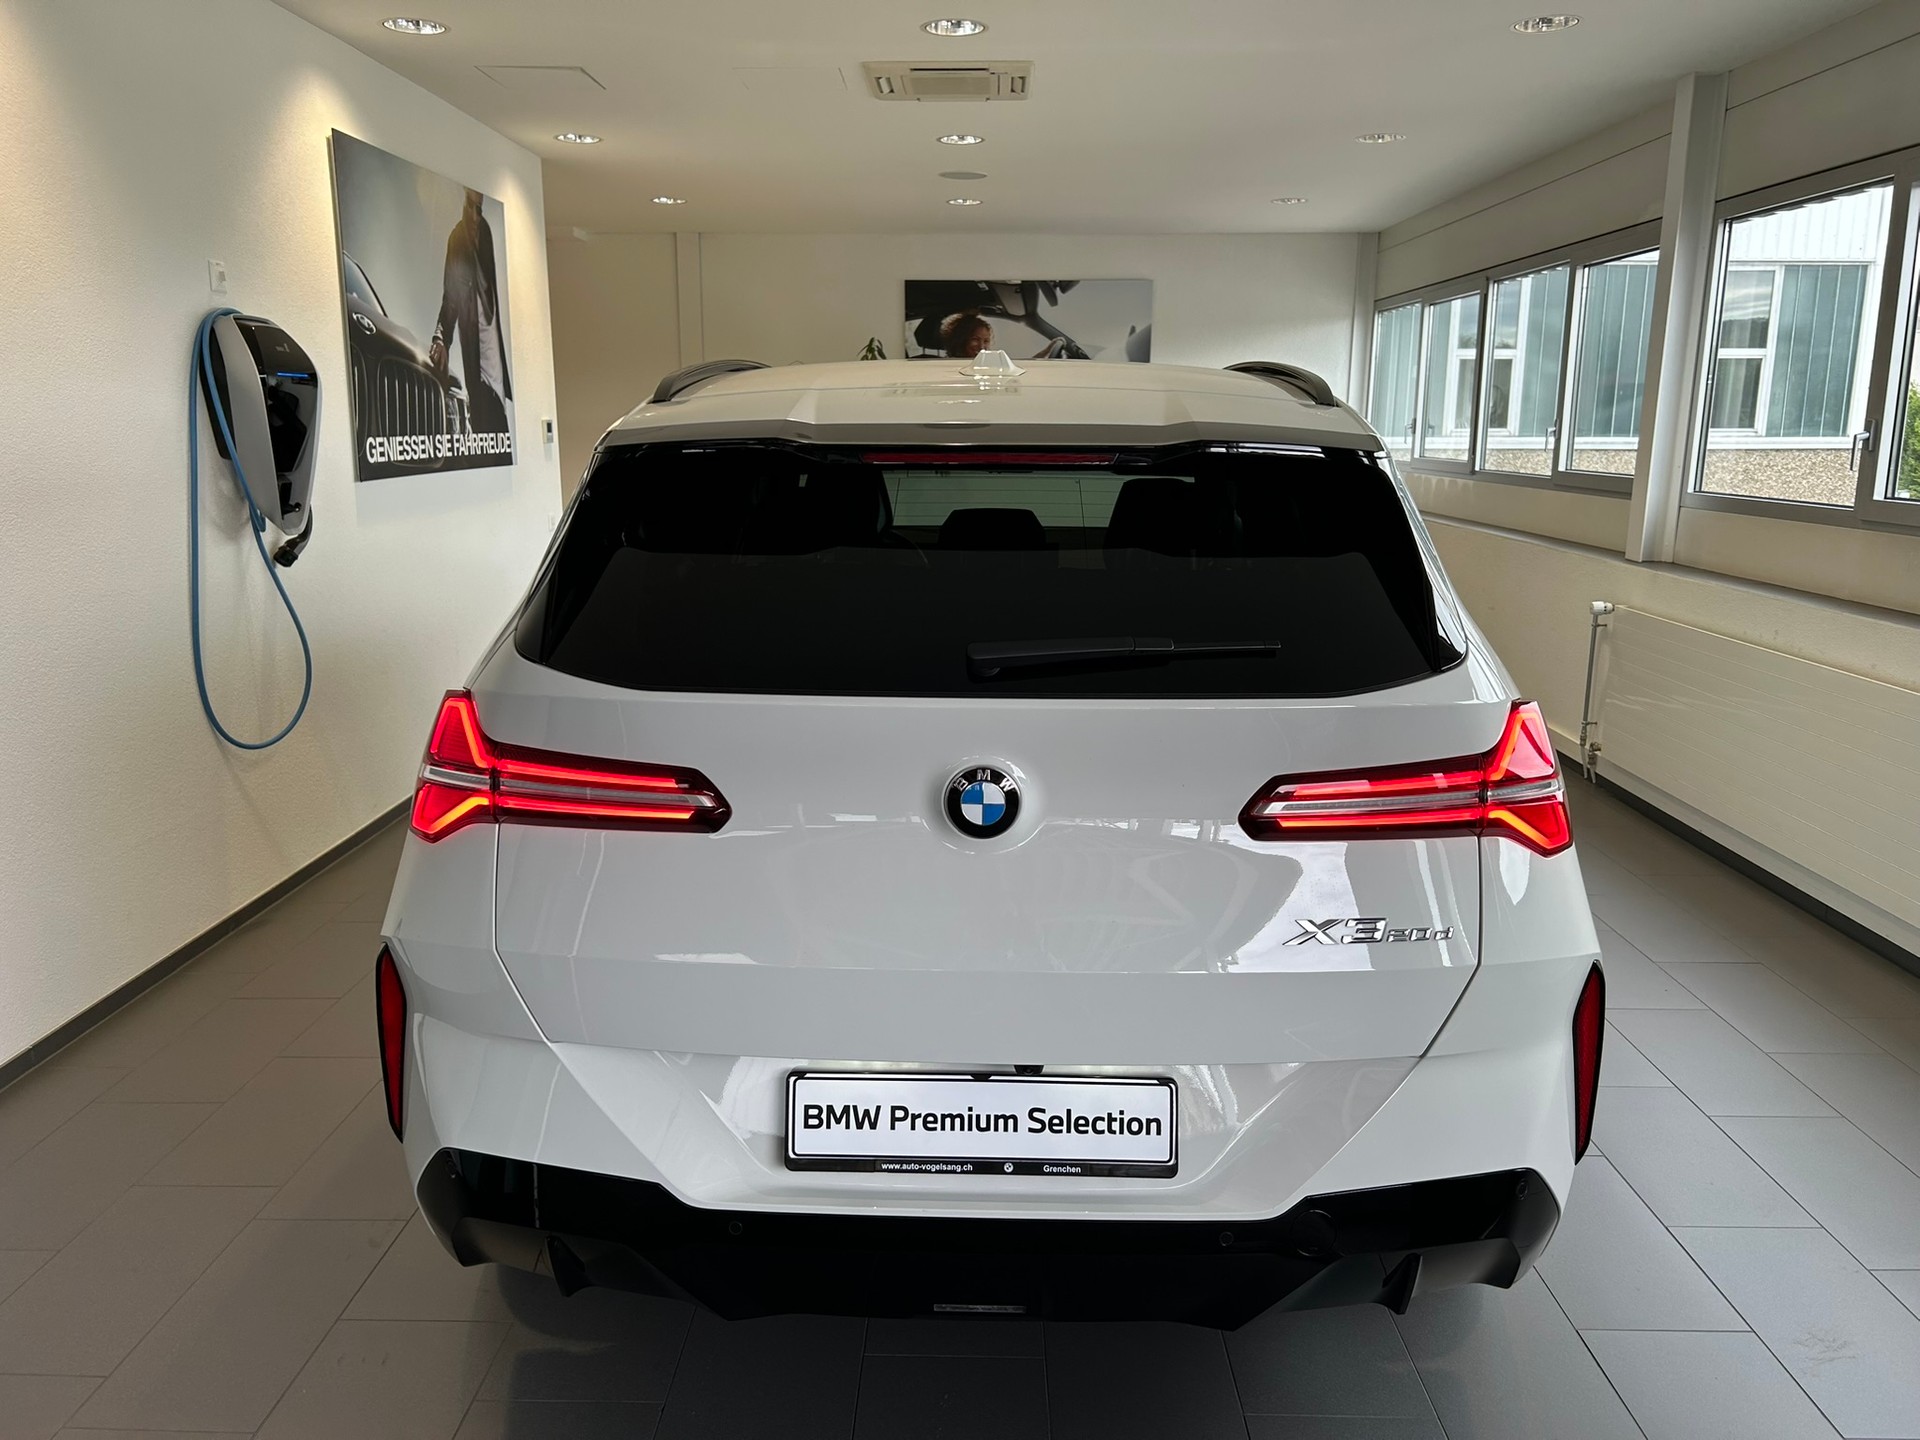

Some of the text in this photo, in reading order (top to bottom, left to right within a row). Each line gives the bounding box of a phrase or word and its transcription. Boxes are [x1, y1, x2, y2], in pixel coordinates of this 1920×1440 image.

[366, 432, 512, 463] GENIESSEN SIE FAHRFREUDE
[953, 769, 1016, 792] BMW
[803, 1104, 1162, 1136] BMW Premium Selection
[881, 1162, 1081, 1173] www.auto-vogelsang.ch Grenchen
